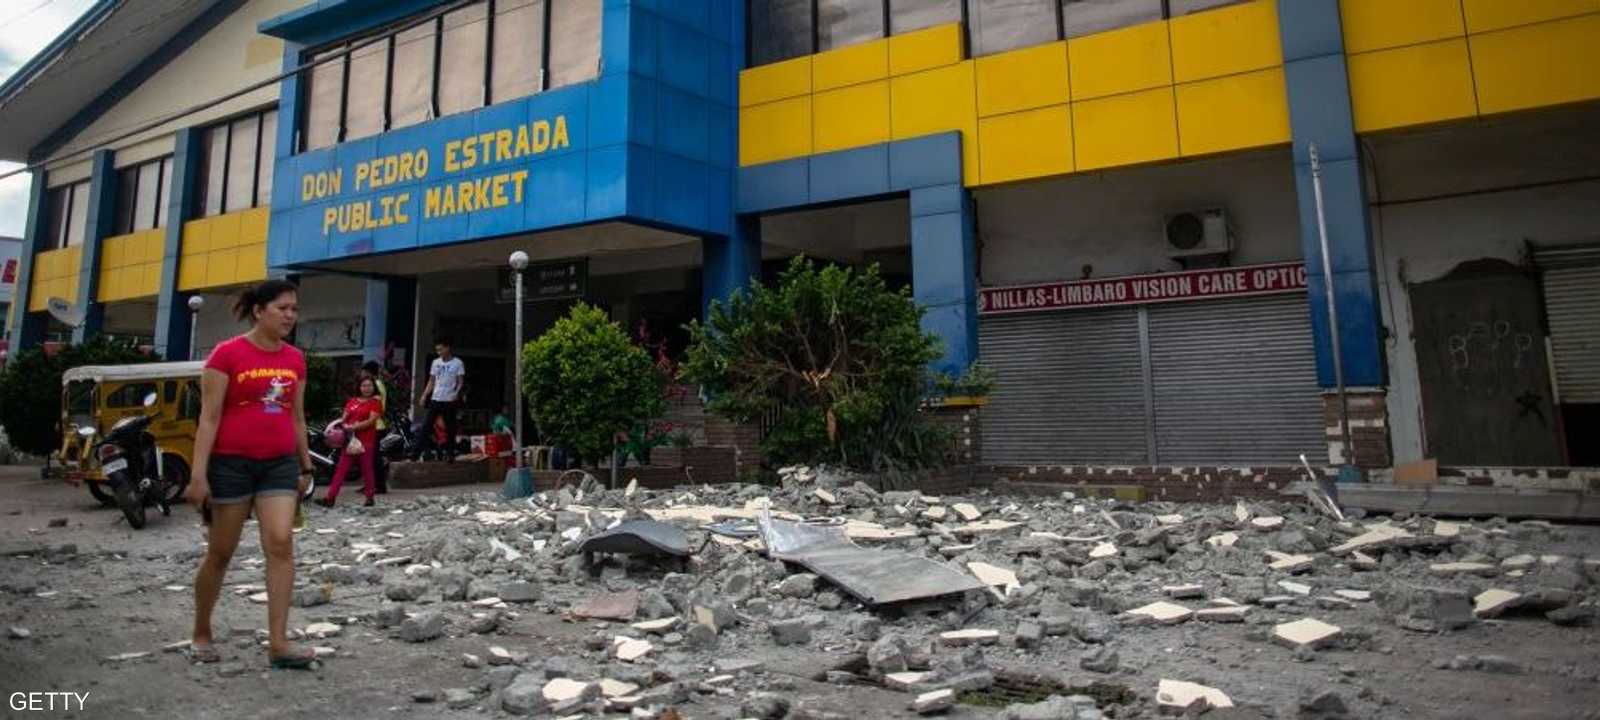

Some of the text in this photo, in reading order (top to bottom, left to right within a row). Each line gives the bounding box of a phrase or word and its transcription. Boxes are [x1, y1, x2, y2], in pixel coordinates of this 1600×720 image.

[302, 115, 569, 200] DON PEDRO ESTRADA
[322, 170, 527, 234] PUBLIC MARKET
[991, 281, 1126, 309] NILLAS-LIMBARO
[1131, 276, 1192, 299] VISION
[1198, 269, 1248, 294] CARE
